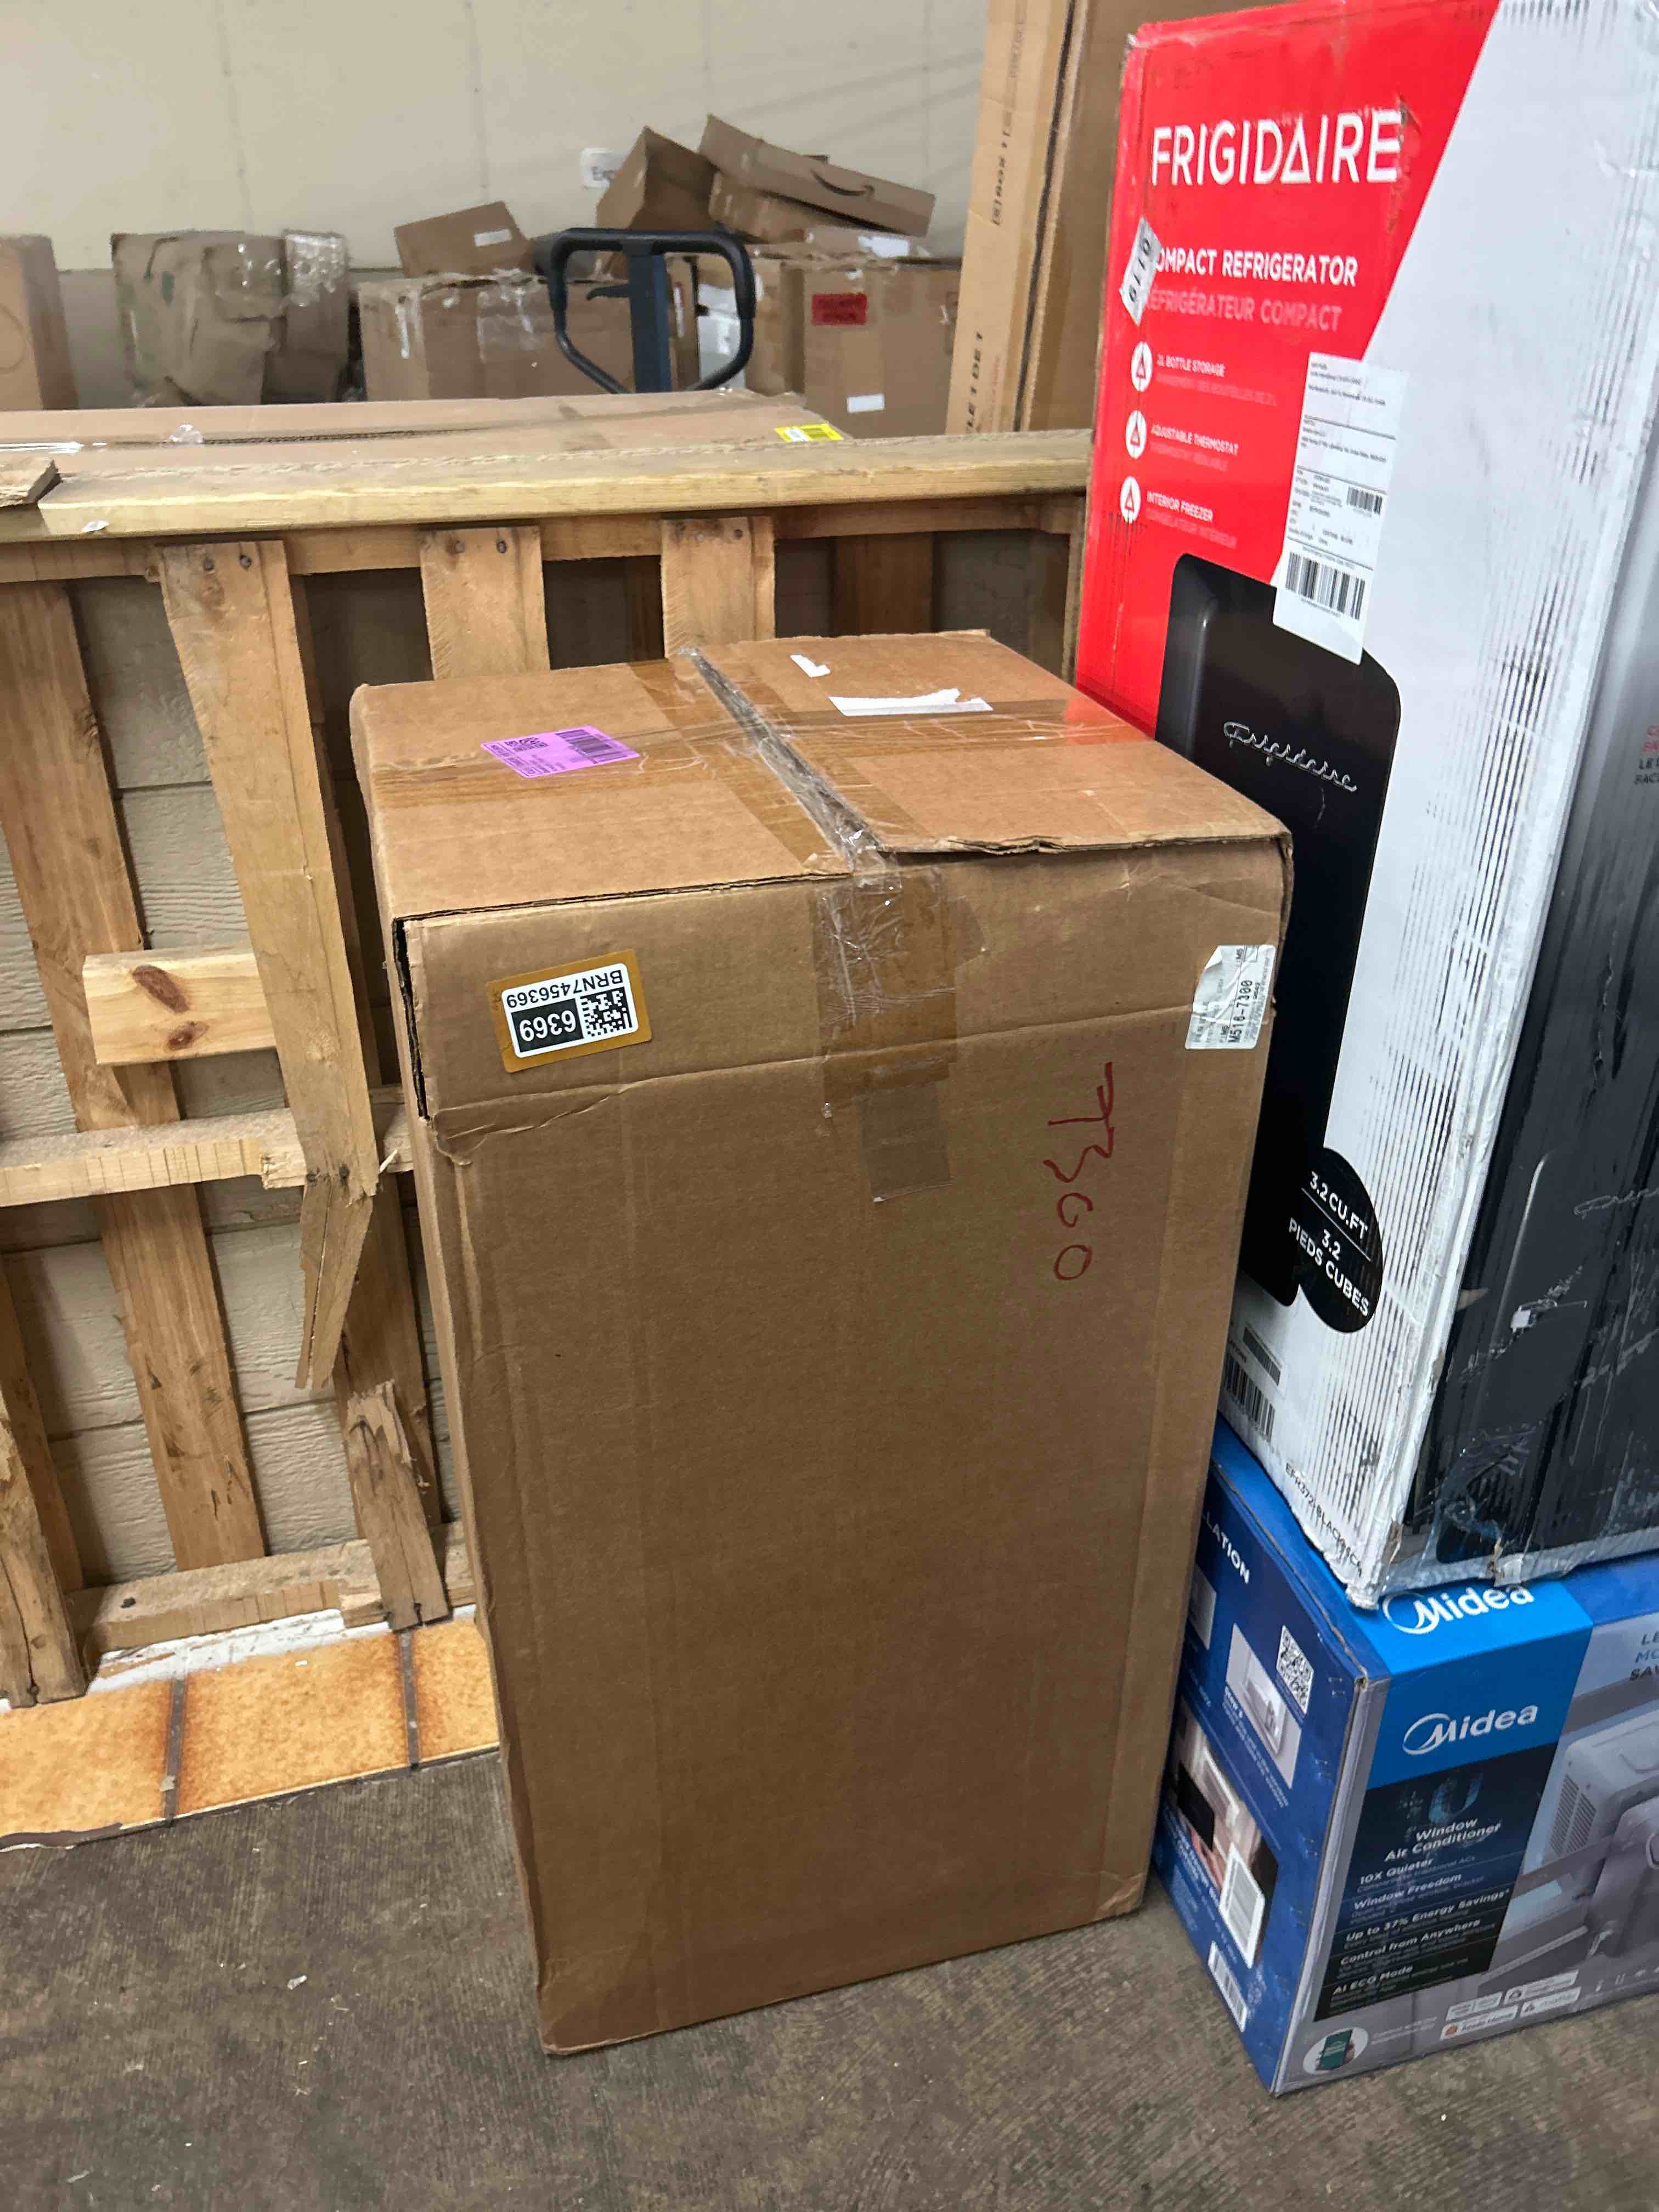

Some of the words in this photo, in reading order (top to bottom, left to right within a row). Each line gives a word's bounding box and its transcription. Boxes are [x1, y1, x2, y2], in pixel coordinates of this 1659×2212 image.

[1152, 109, 1402, 186] FRIGIDAIRE
[1154, 247, 1217, 276] OMPACT
[1221, 249, 1358, 287] REFRIGERATOR
[1259, 303, 1342, 331] COMPACT
[1180, 499, 1214, 523] FREEZER
[506, 969, 624, 1009] BRN7456369
[518, 1009, 577, 1042] 6369
[1321, 1228, 1341, 1261] 3.2
[1288, 1217, 1324, 1266] PIEDS
[1325, 1260, 1370, 1317] CUBES
[1383, 1586, 1534, 1635] Midea
[1402, 1705, 1538, 1755] Midea
[1384, 1848, 1408, 1862] Air
[1412, 1821, 1502, 1854] Conditioner
[1415, 1818, 1478, 1842] Window
[1359, 1871, 1383, 1886] 10X
[1386, 1857, 1434, 1877] Quieter
[1353, 1890, 1406, 1910] Window
[1407, 1874, 1462, 1894] Freedom
[1346, 1931, 1364, 1942] Up
[1367, 1926, 1380, 1936] to
[1412, 1905, 1455, 1923] Energy
[1340, 1944, 1386, 1966] Control
[1388, 1936, 1418, 1953] from
[1420, 1919, 1481, 1943] Anywhere
[1350, 1975, 1377, 1991] ECO
[1379, 1965, 1413, 1982] Mode
